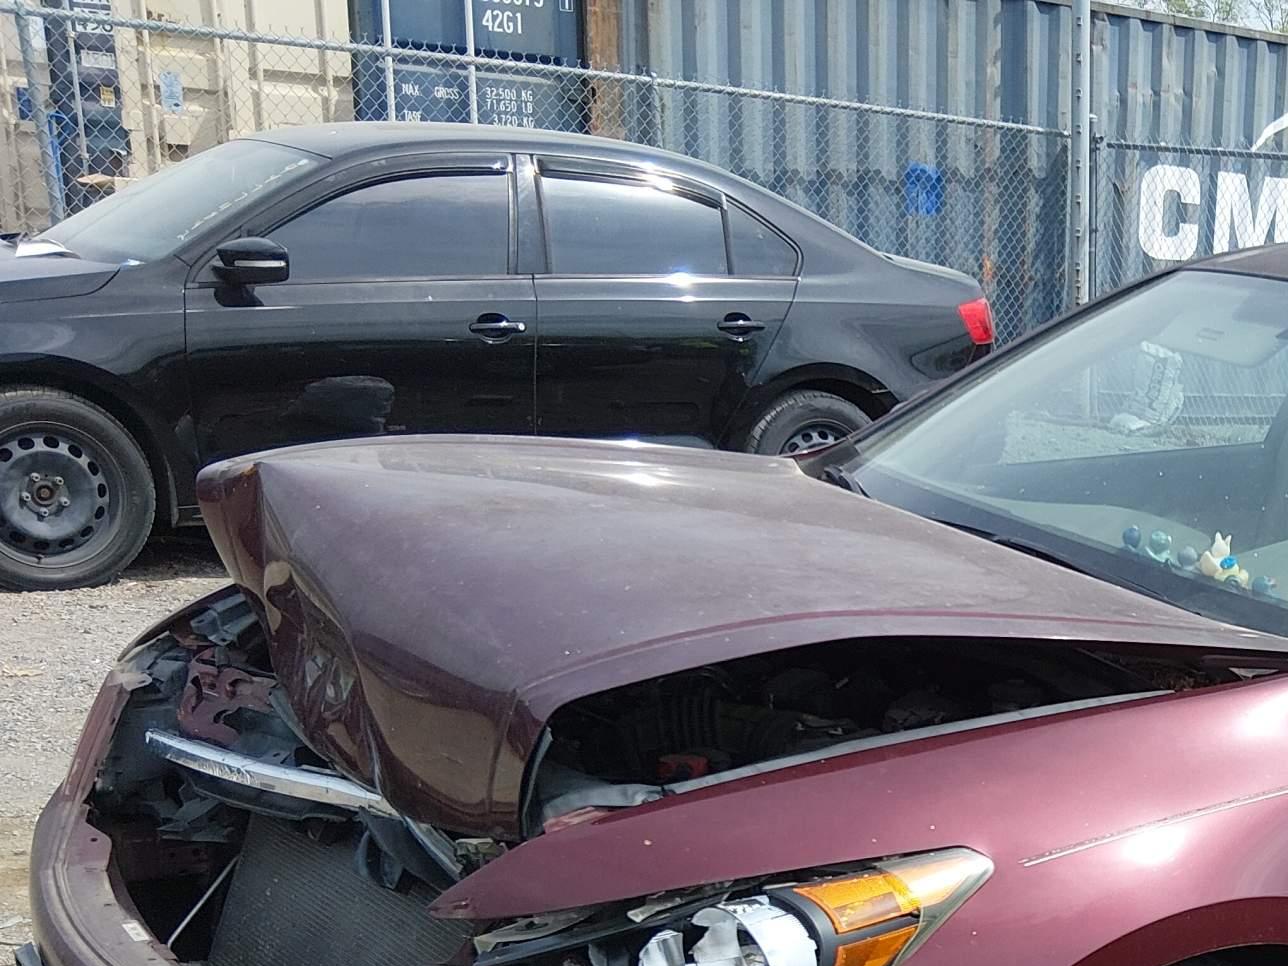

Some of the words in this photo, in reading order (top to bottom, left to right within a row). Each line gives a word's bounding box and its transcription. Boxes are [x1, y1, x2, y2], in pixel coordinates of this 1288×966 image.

[482, 9, 522, 35] 42G1
[521, 90, 533, 102] KG
[522, 102, 533, 113] LB
